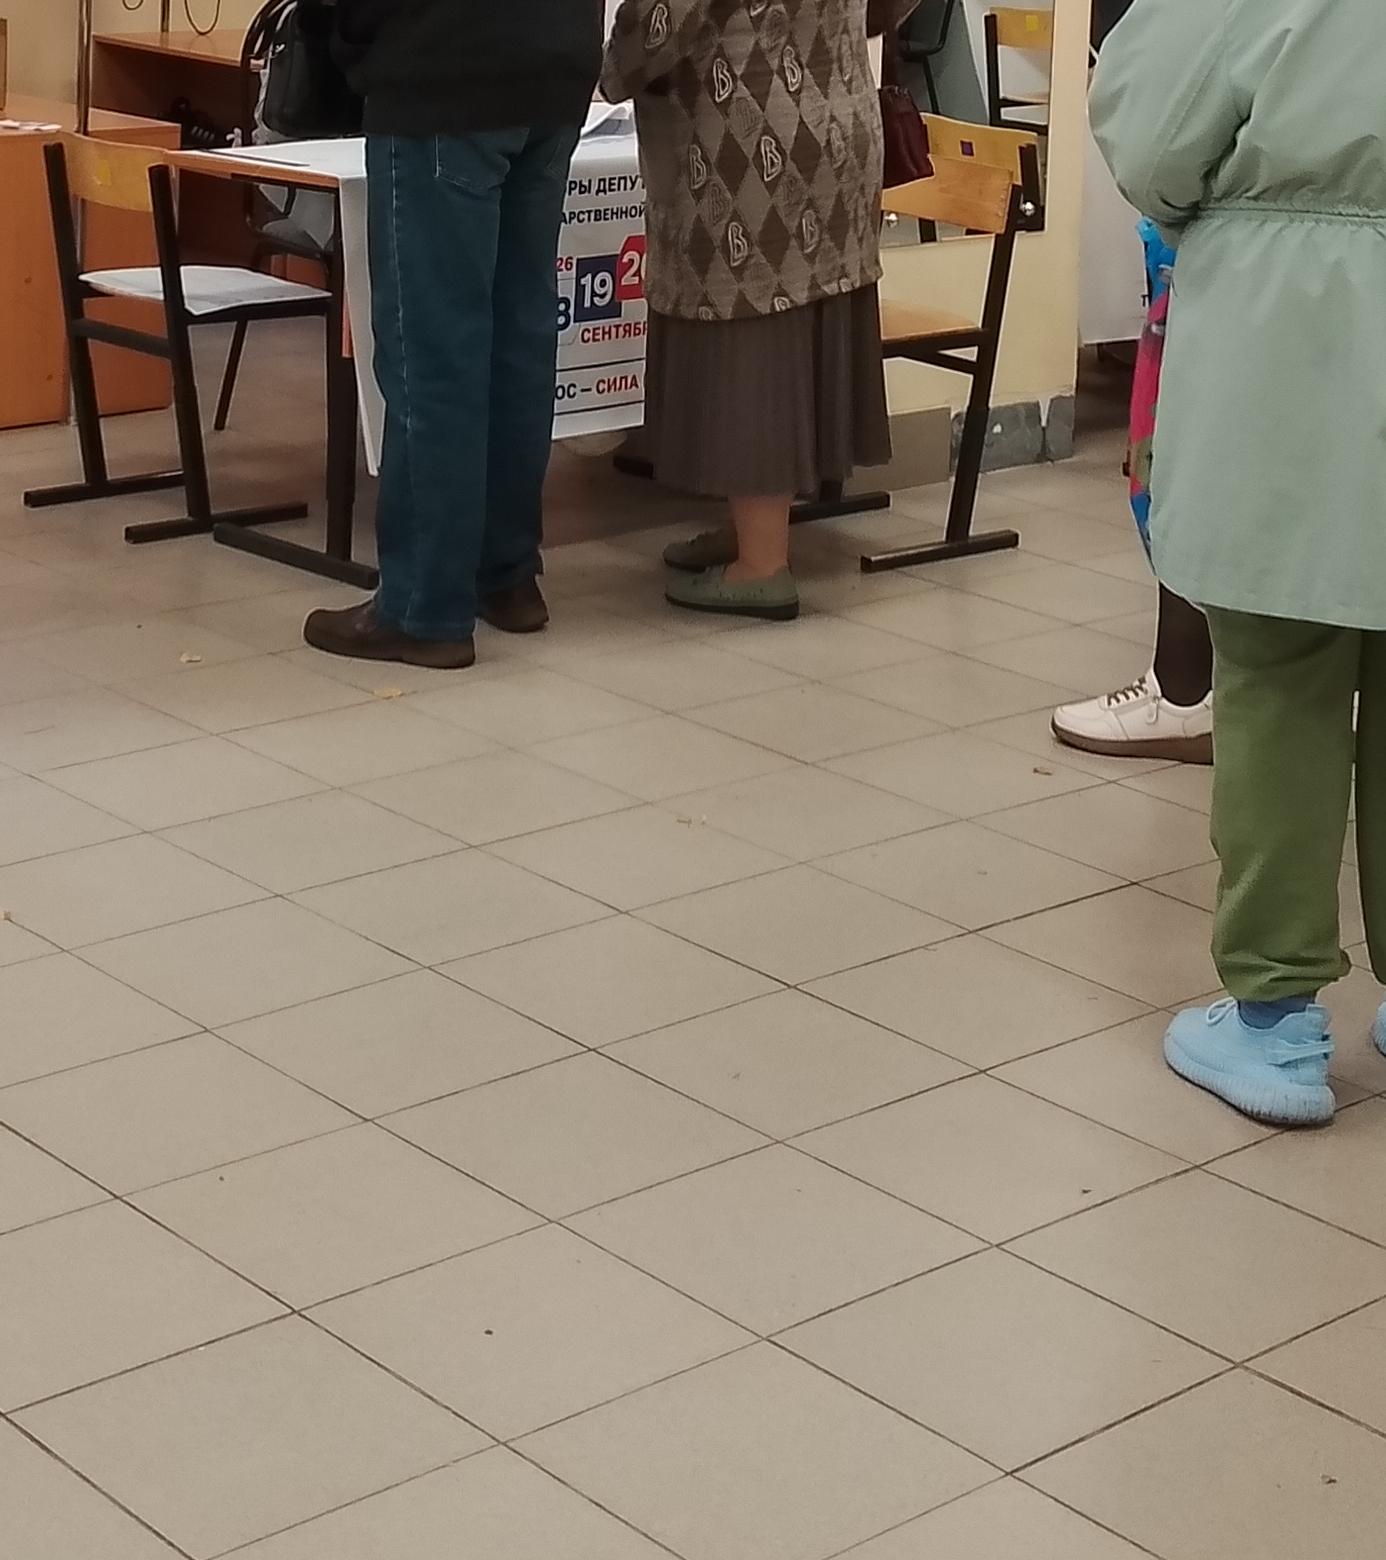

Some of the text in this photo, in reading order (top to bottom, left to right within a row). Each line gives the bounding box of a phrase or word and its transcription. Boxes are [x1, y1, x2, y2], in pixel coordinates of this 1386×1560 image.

[557, 256, 573, 271] 26
[580, 272, 613, 308] 19
[581, 321, 646, 343] СЕНТЯБ
[596, 374, 639, 394] СИЛА
